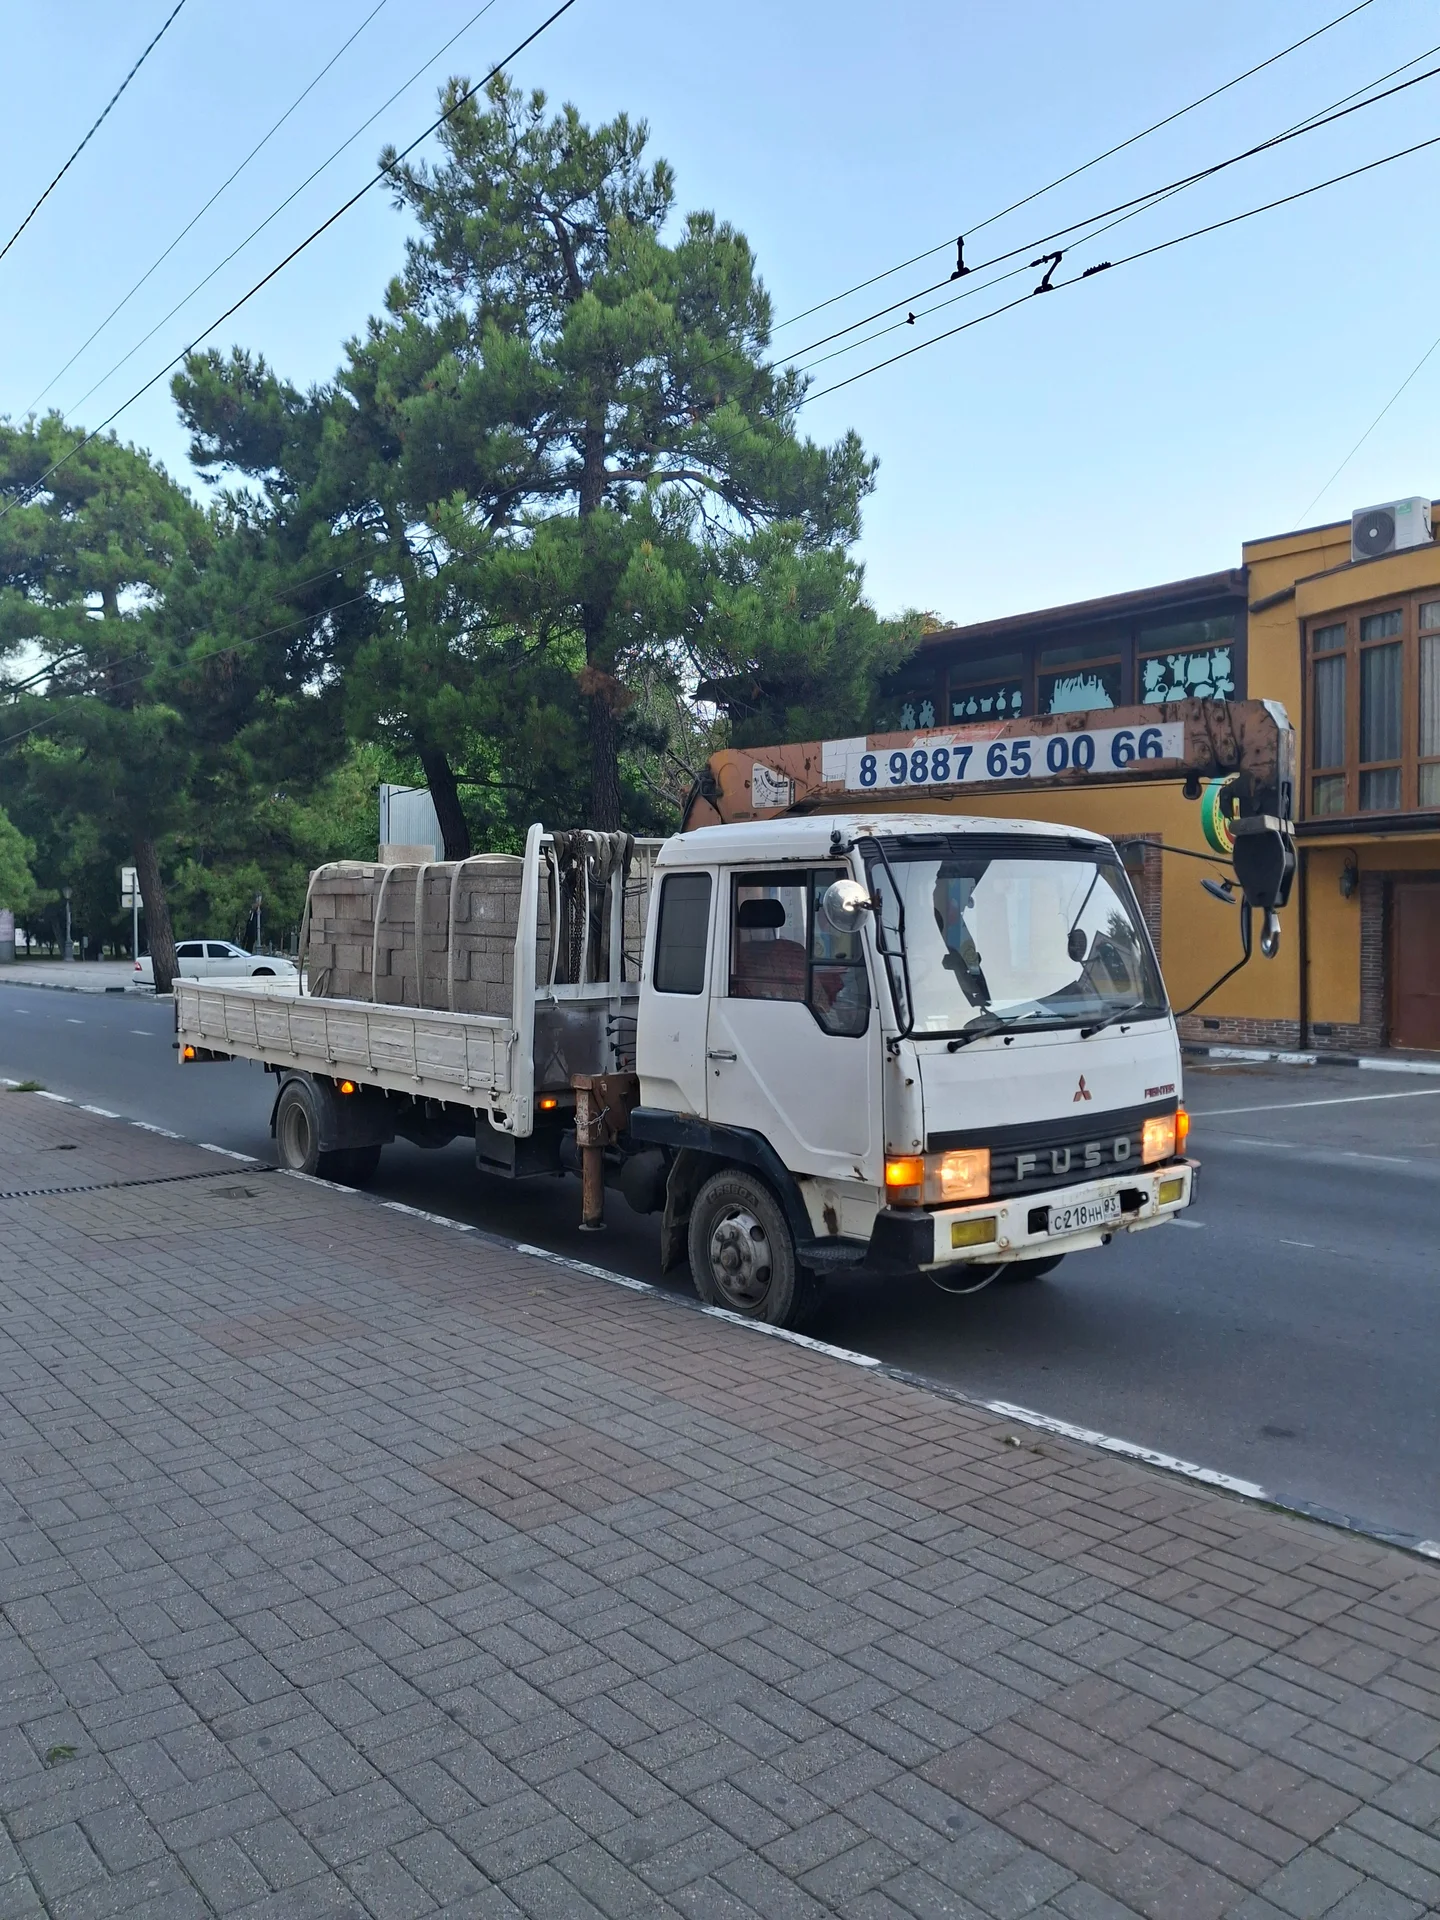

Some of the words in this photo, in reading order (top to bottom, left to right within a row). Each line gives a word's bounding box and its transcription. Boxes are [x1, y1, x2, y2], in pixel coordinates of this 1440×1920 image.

[859, 755, 876, 787] 8
[890, 747, 972, 785] 9887
[987, 741, 1031, 776] 65
[1048, 734, 1094, 772] 00
[1112, 729, 1162, 768] 66
[1017, 1138, 1131, 1180] FUSO
